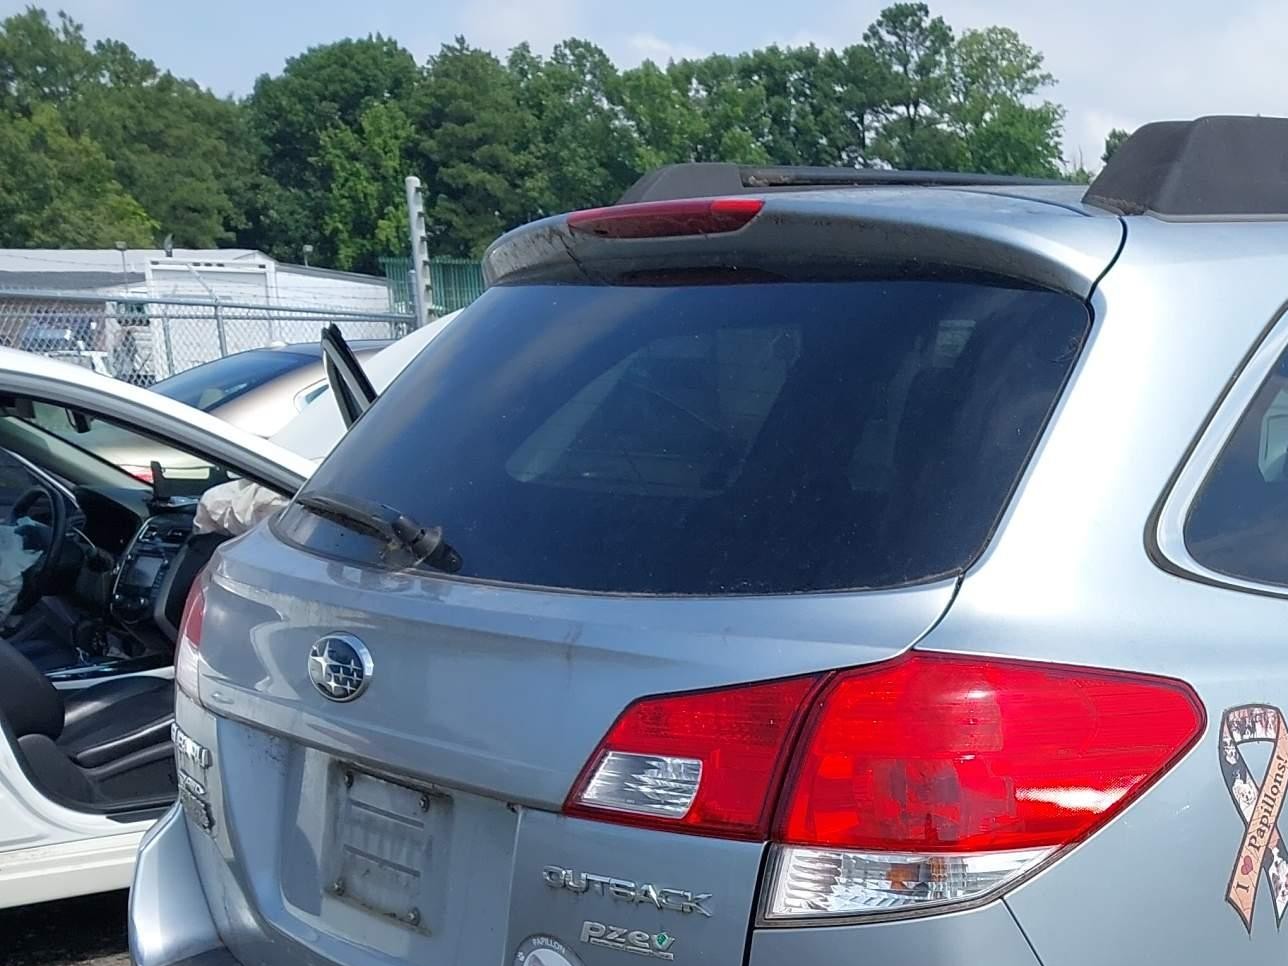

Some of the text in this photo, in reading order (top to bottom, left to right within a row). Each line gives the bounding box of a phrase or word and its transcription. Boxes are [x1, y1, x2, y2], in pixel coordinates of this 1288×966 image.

[1235, 756, 1288, 894] I Papillons!
[542, 865, 713, 918] OUTBACK
[532, 936, 567, 954] PAPILLON
